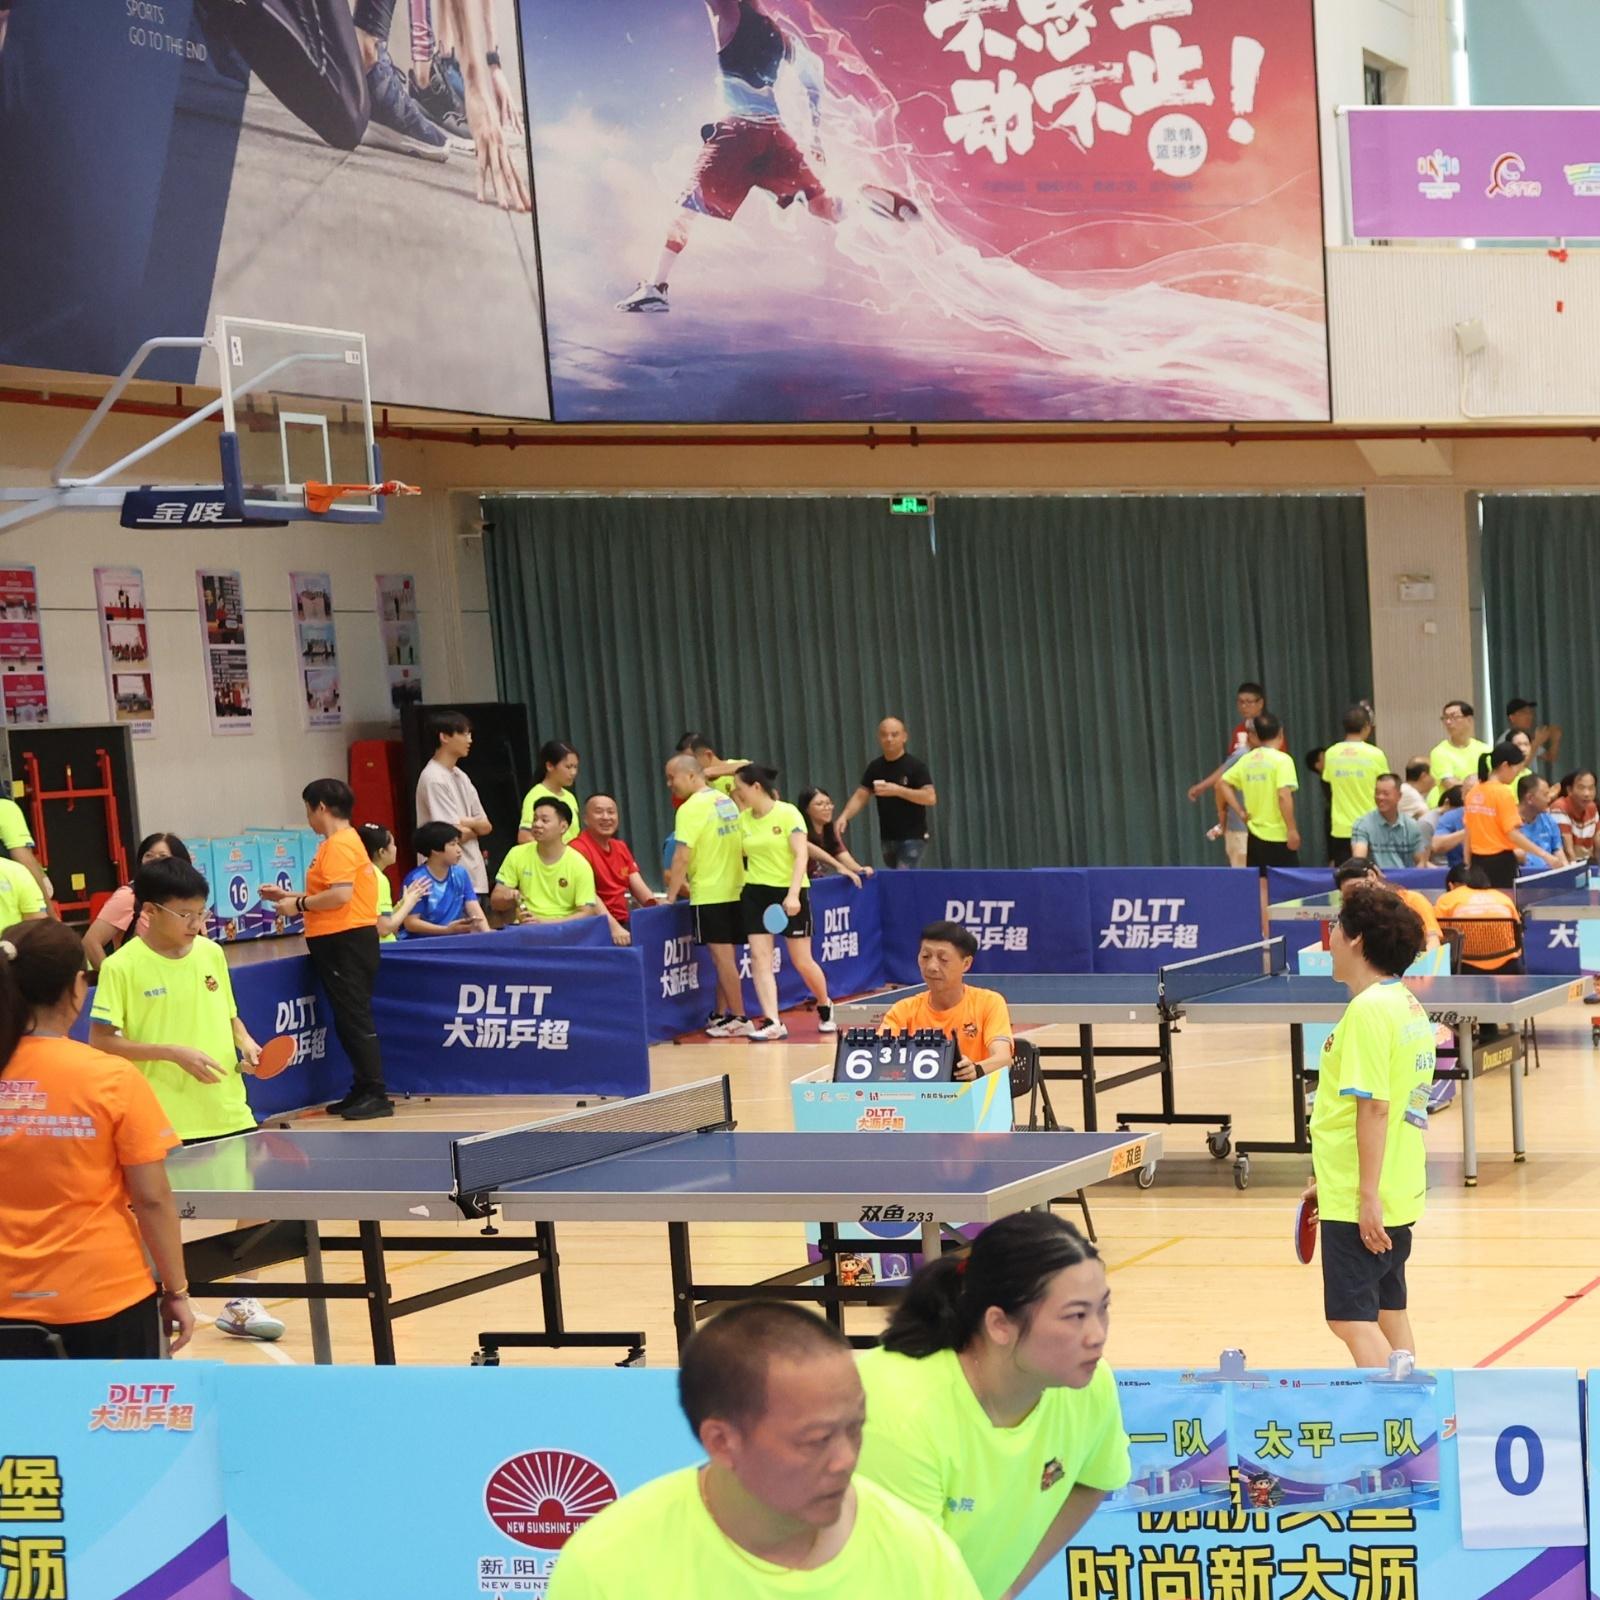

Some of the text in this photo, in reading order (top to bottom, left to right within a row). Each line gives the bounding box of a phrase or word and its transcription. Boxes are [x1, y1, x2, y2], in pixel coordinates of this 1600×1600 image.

[129, 26, 207, 61] GO TO THE END
[1162, 127, 1193, 142] 激情
[153, 502, 227, 523] 金陵
[231, 884, 248, 904] 16
[825, 906, 851, 934] DLTT
[945, 900, 1015, 925] DLTT
[1111, 899, 1185, 923] DLTT
[1100, 923, 1198, 950] 大沥乒超
[457, 984, 552, 1015] DLTT
[276, 995, 316, 1033] DLTT
[442, 1017, 570, 1050] 大沥乒超
[846, 1049, 873, 1080] 6
[879, 1047, 892, 1064] 3
[912, 1049, 940, 1080] 6
[866, 1108, 895, 1117] DLTT
[859, 1204, 933, 1223] 双鱼 233
[108, 1384, 175, 1404] DLTT
[89, 1404, 195, 1432] 大沥乒超
[1130, 1419, 1210, 1458] 一队
[1255, 1418, 1421, 1459] 太平一队
[1494, 1424, 1545, 1496] 0
[507, 1522, 525, 1533] NEW
[527, 1522, 571, 1534] SUNSHINE
[482, 1581, 510, 1589] NEW
